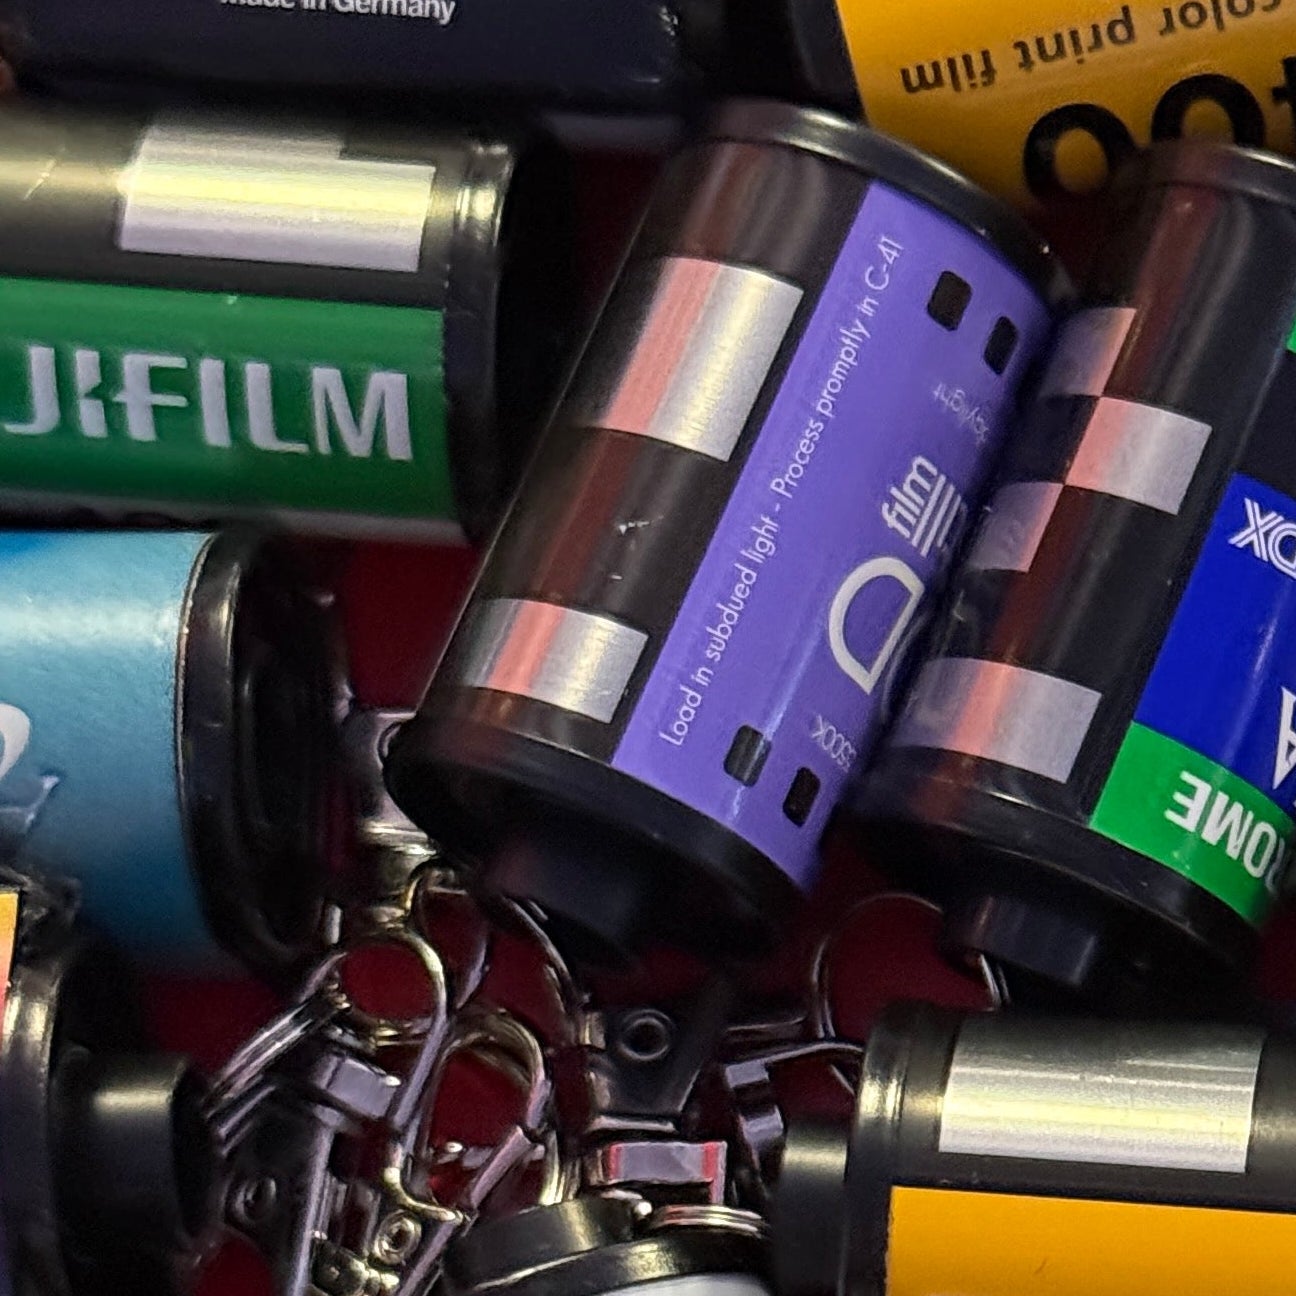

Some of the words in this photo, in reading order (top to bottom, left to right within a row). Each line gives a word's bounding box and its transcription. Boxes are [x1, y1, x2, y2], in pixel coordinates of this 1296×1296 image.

[900, 49, 998, 94] film
[1012, 5, 1136, 72] print
[864, 234, 905, 291] C-41
[855, 289, 880, 318] in
[816, 315, 873, 418] promptly
[770, 413, 824, 500] Process
[881, 455, 939, 541] film
[741, 514, 781, 586] light
[703, 564, 758, 664] subdued
[690, 655, 715, 687] in
[659, 671, 702, 746] Load
